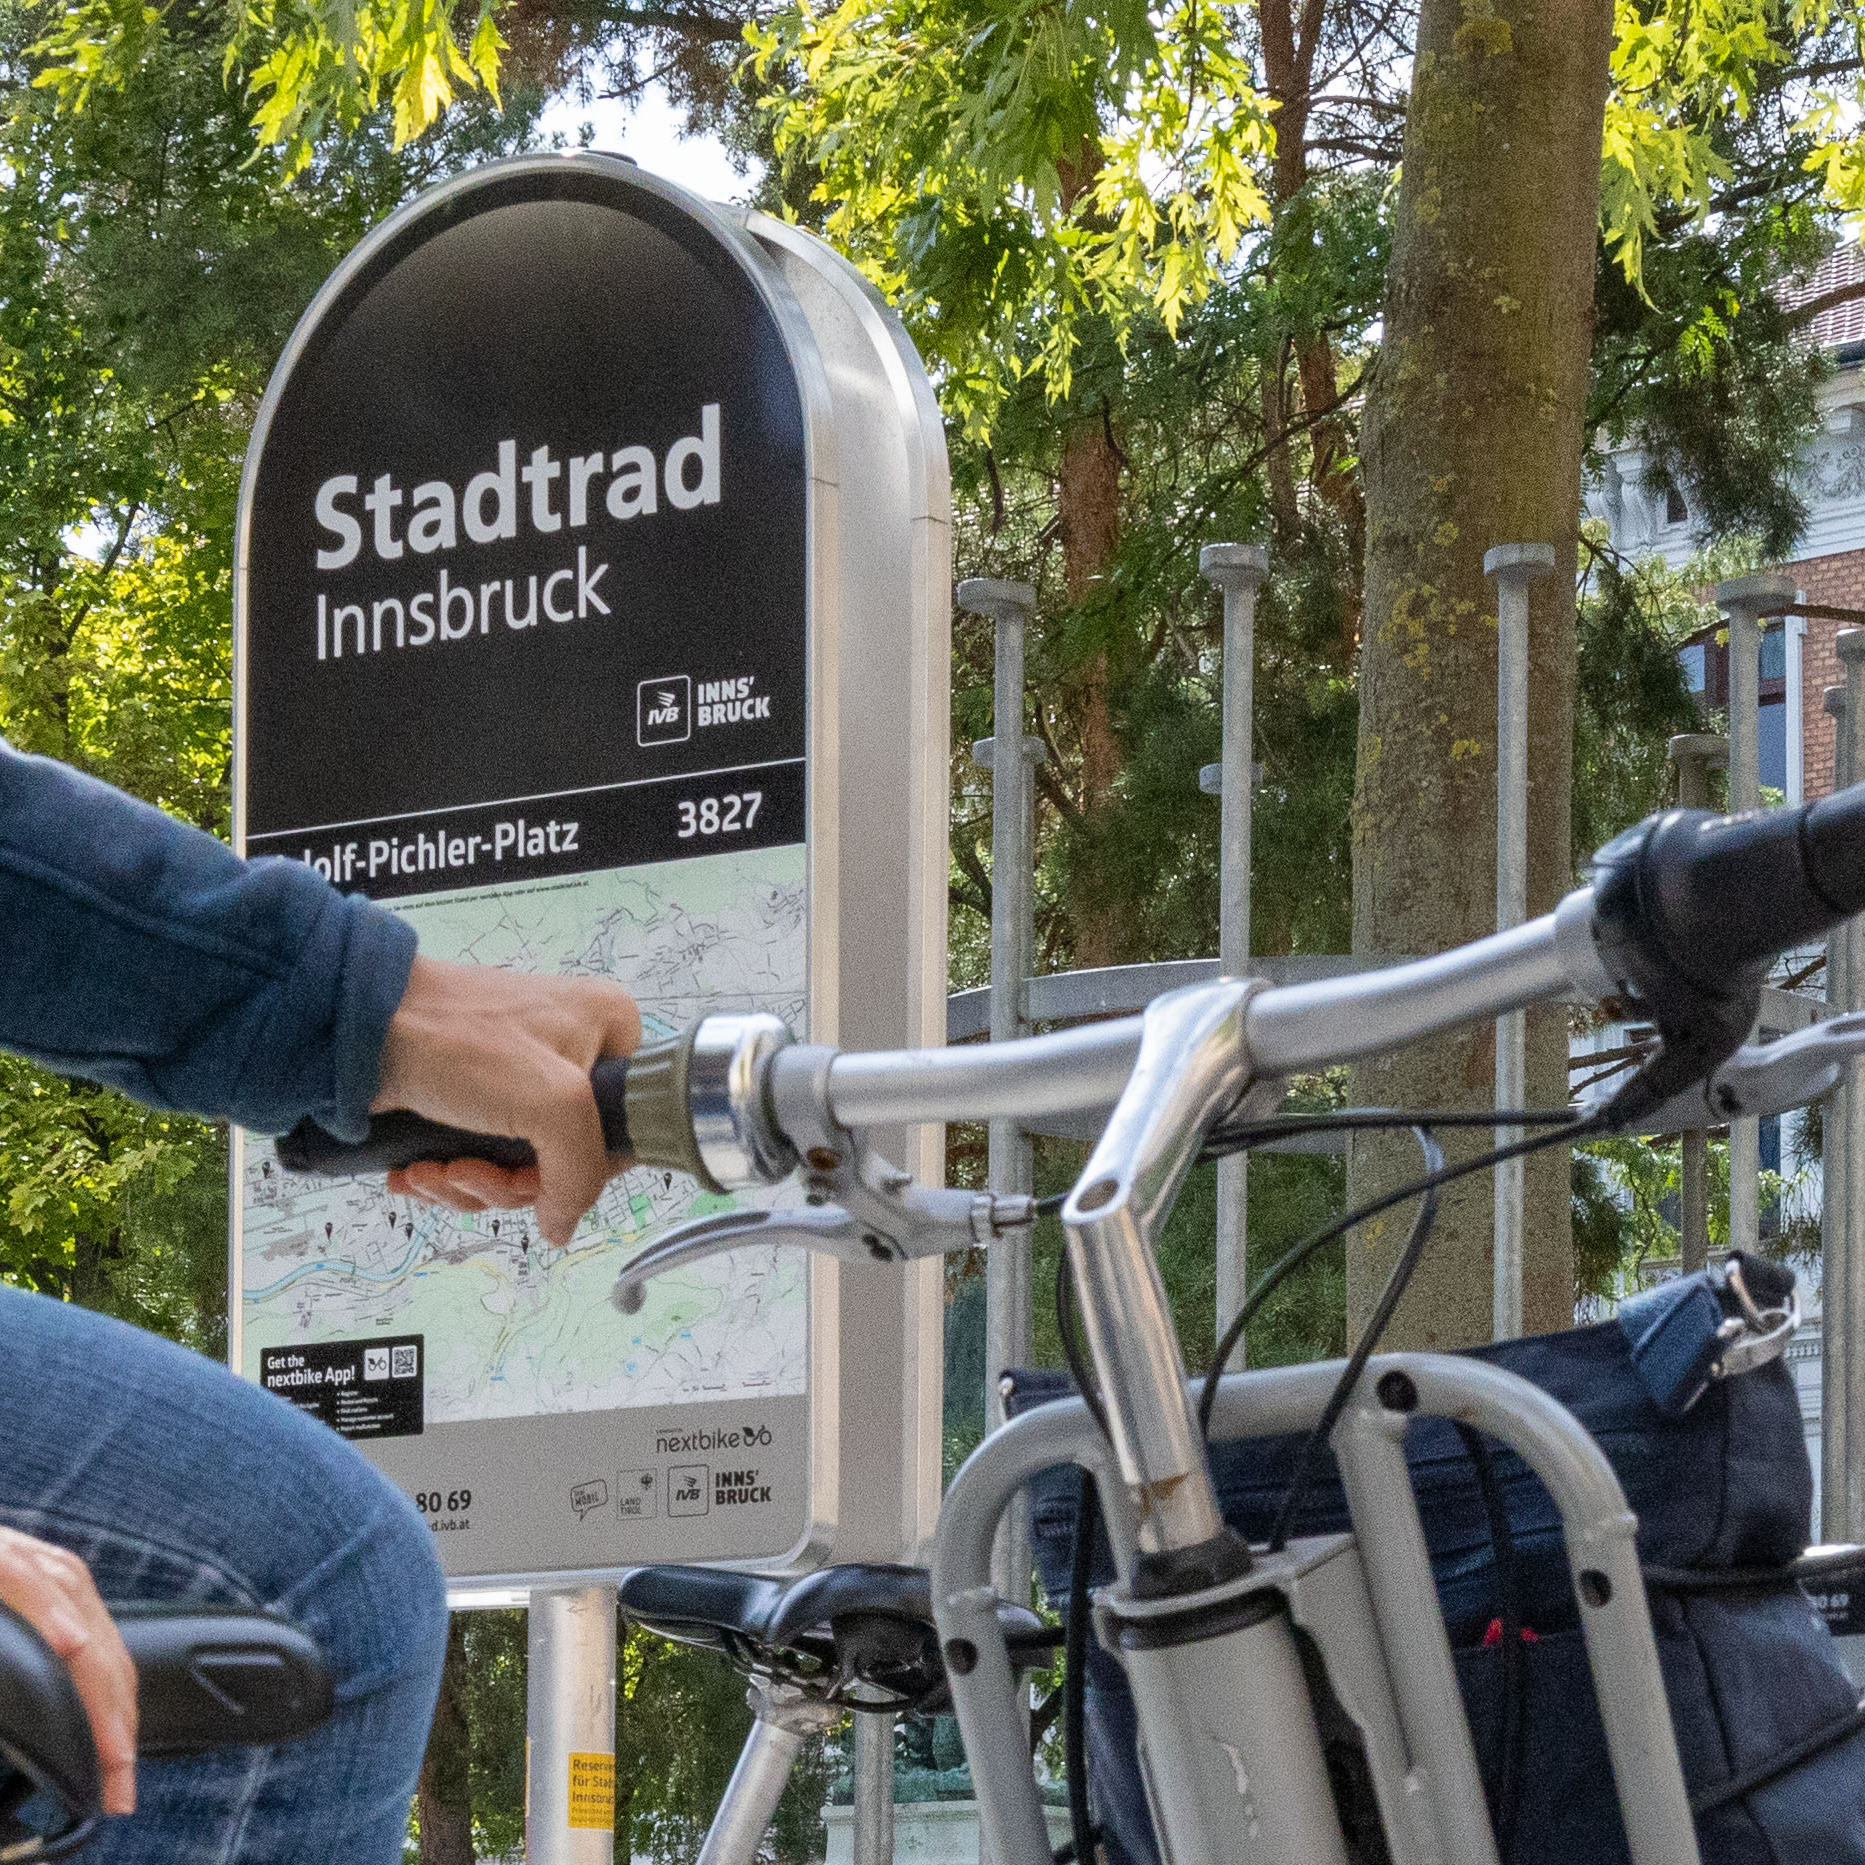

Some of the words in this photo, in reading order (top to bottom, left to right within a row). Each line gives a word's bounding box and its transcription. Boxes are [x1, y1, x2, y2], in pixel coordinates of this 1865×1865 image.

[315, 402, 722, 570] Stadtrad
[316, 546, 612, 660] Innsbruck
[697, 675, 755, 704] INNS'
[647, 706, 681, 726] IVB
[697, 696, 771, 727] BRUCK
[305, 818, 580, 882] olf-Pichler-Platz
[677, 791, 763, 838] 3827
[267, 1356, 286, 1369] Get
[287, 1354, 305, 1369] the
[267, 1367, 322, 1388] nextbike
[324, 1364, 356, 1387] App!
[656, 1428, 740, 1453] nextbike
[416, 1492, 441, 1513] 80
[447, 1489, 472, 1512] 69
[676, 1488, 701, 1501] IVB
[715, 1486, 771, 1505] BRUCK
[429, 1518, 470, 1532] d.ivb.at
